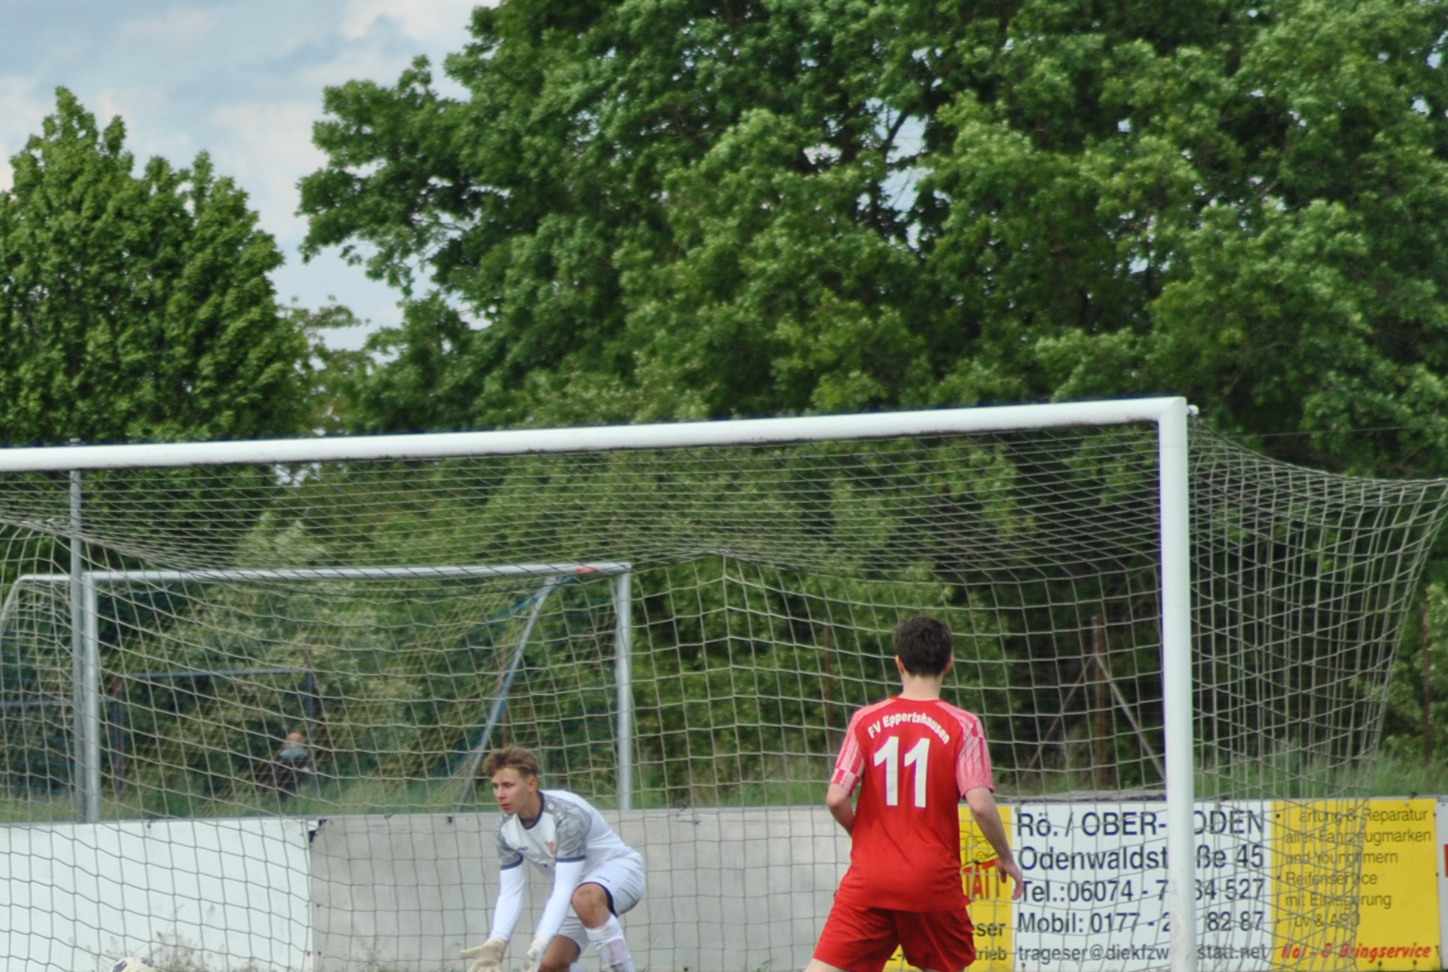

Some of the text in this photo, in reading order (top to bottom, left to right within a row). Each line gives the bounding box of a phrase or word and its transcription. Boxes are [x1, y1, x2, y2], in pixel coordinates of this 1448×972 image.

[867, 712, 950, 745] FV Eppertshausen
[874, 735, 931, 808] 11
[1017, 812, 1058, 837] Rö.
[1082, 809, 1264, 837] OBER-ODEN
[1362, 808, 1428, 824] Reparatur
[1018, 843, 1263, 870] Odenwaldstße 45
[1225, 878, 1266, 900] 527
[1286, 872, 1378, 886] Reifenservce
[1018, 912, 1084, 933] Mobil:
[1090, 911, 1140, 933] 0177
[1207, 911, 1232, 932] 82
[1240, 911, 1264, 932] 87
[1019, 944, 1268, 965] trageser@diekfzwstatt.net
